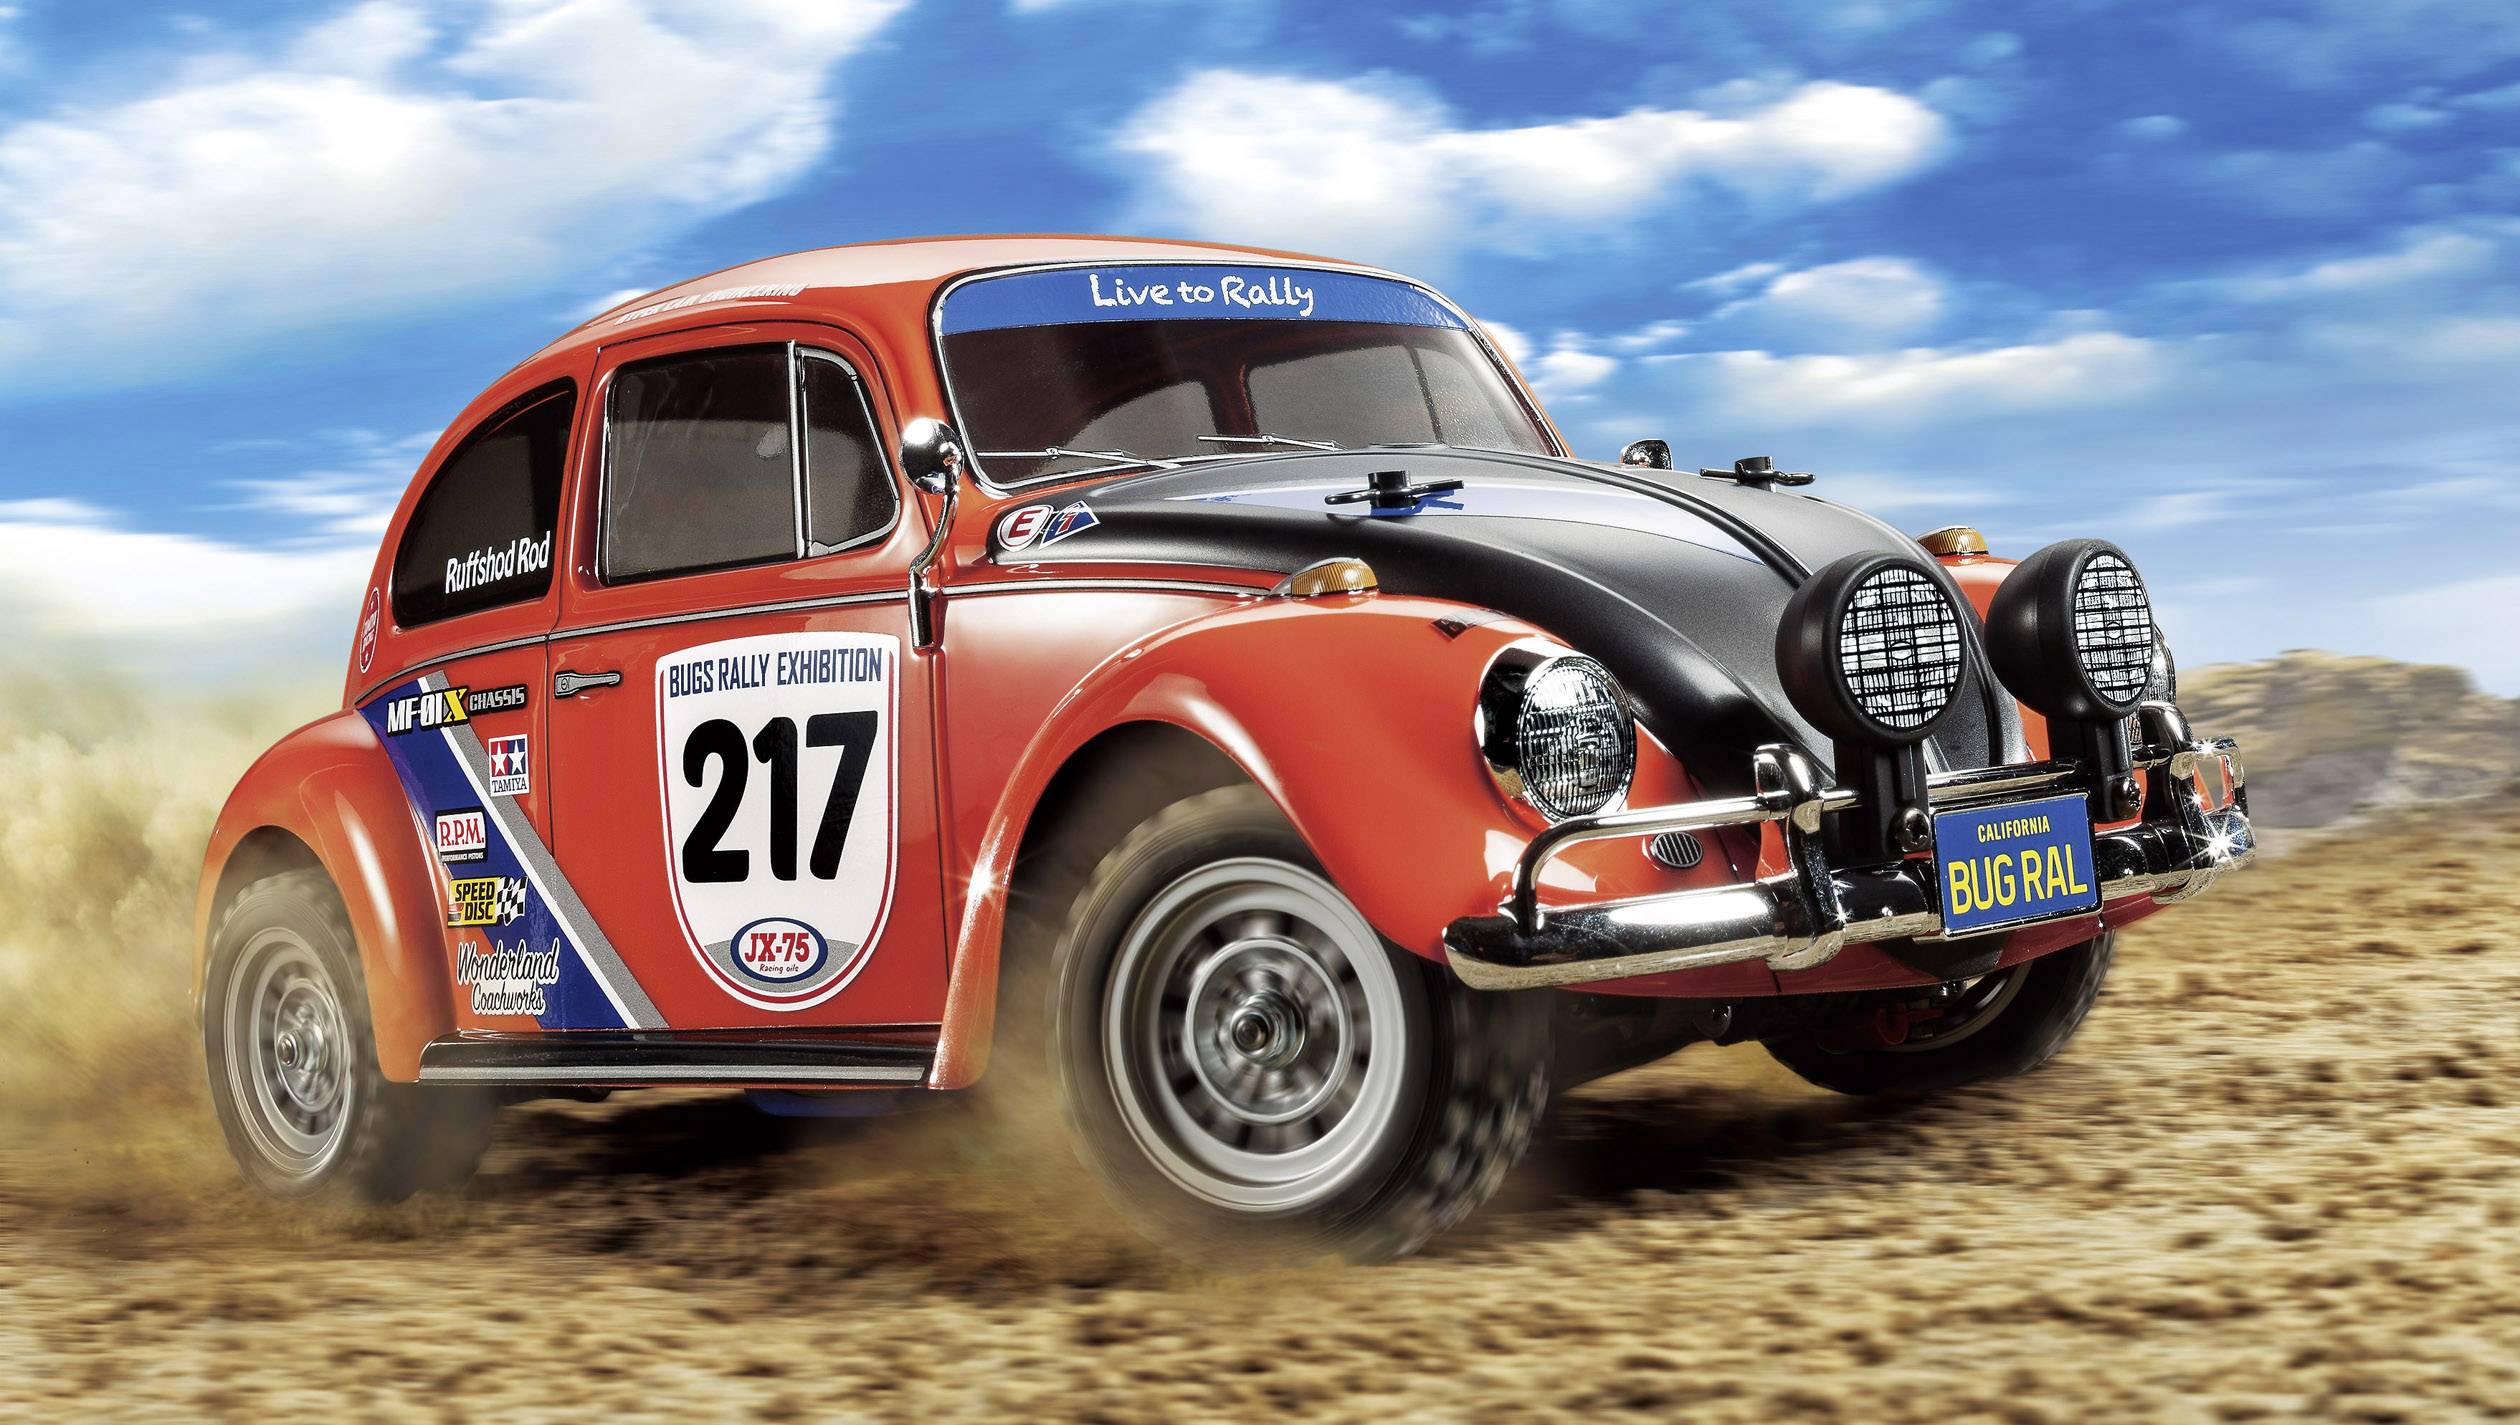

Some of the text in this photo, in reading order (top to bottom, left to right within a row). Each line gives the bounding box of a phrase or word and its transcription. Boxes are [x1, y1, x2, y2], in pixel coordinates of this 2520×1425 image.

[1089, 274, 1314, 317] Live to Rally
[1008, 509, 1042, 539] E
[445, 530, 551, 594] Ruffshod Rod
[669, 647, 883, 698] BUGS RALLY EXHIBITION
[469, 686, 526, 712] CHASSIS
[491, 776, 528, 794] TAMIYA
[682, 709, 879, 884] 217
[439, 818, 485, 847] R.P.M.
[1977, 815, 2051, 844] CALIFORNIA
[455, 881, 496, 903] SPEED
[1948, 843, 2089, 916] BUG RAL
[464, 901, 495, 921] DISC
[457, 938, 559, 981] Wonderland
[744, 932, 810, 963] JX-75
[760, 963, 800, 975] Racing oils
[472, 981, 545, 1011] Coachworks
